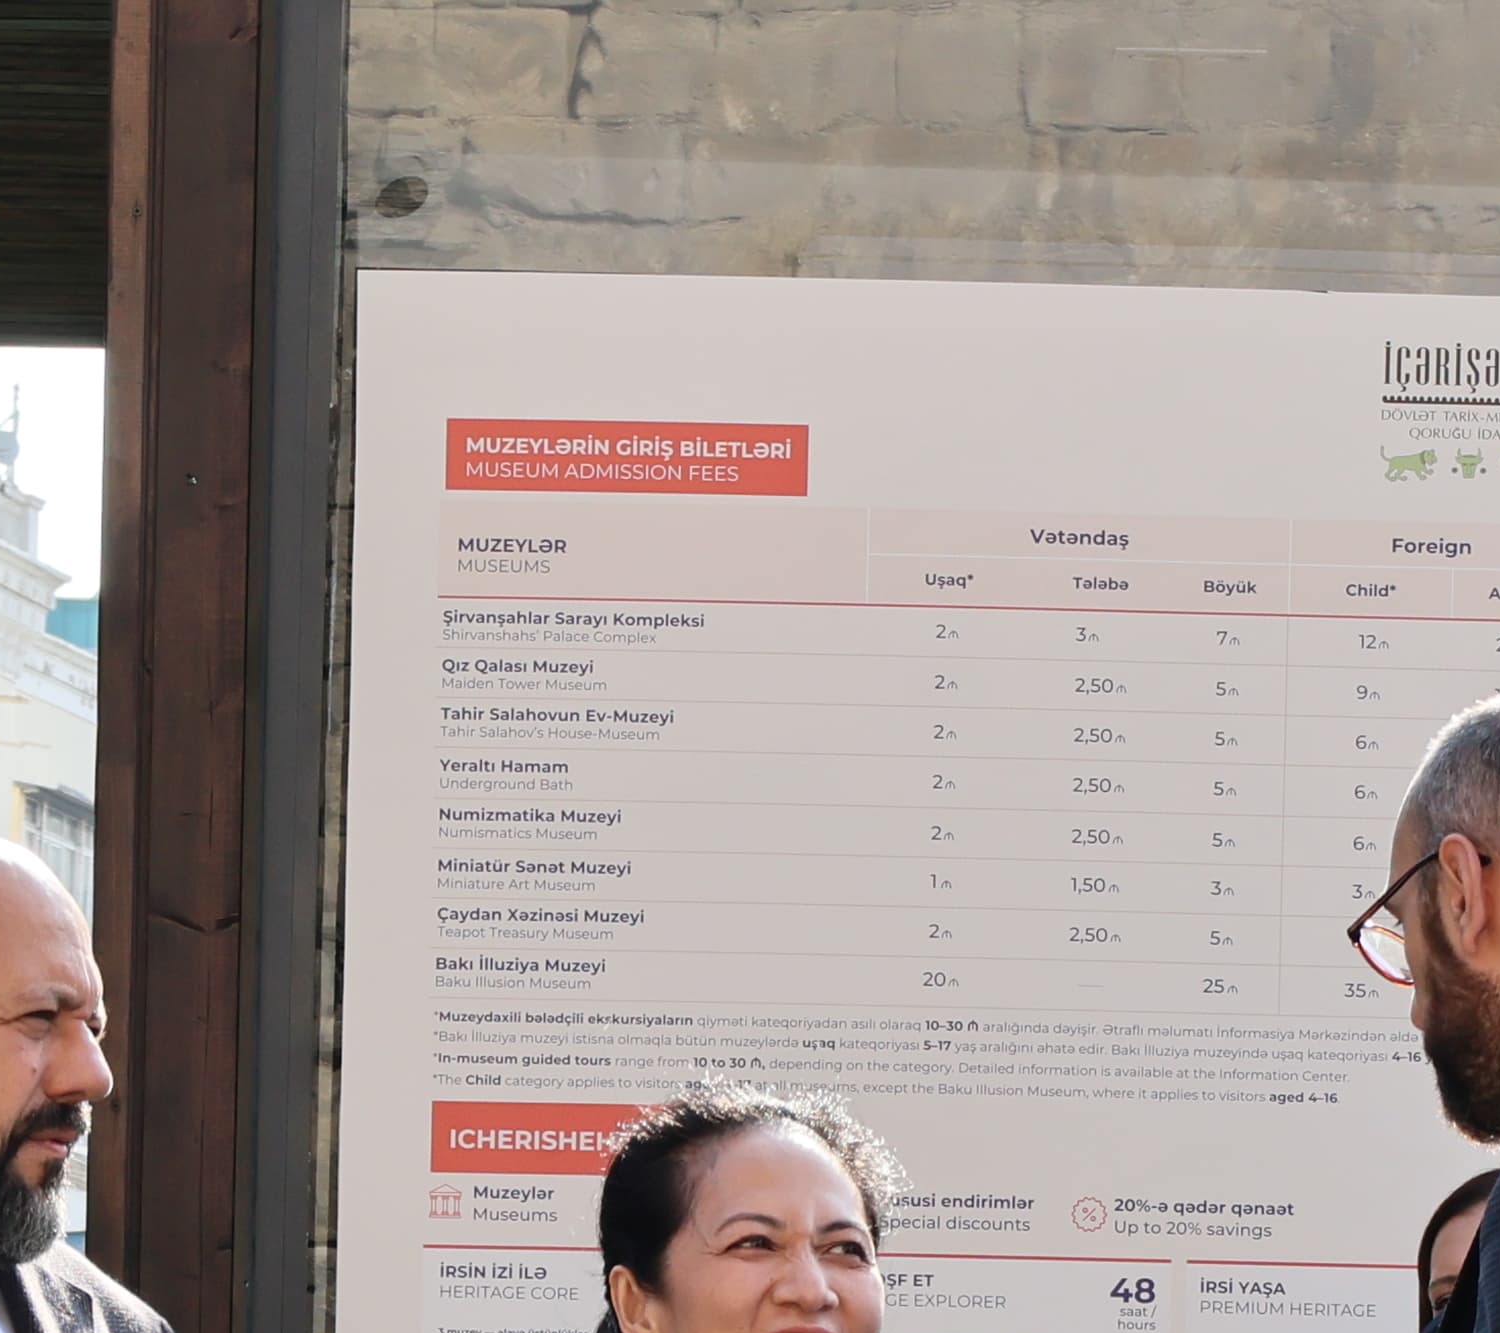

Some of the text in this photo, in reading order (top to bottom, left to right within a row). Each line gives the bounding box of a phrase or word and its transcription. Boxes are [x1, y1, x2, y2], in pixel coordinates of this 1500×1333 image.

[467, 435, 791, 461] MUZEYLƏRİN GİRİŞ BİLETLƏRİ
[467, 462, 738, 481] MUSEUM ADMISSION FEES
[459, 538, 566, 553] MUZEYLƏR
[1030, 529, 1129, 550] Vətəndaş
[1392, 538, 1471, 558] Foreign
[458, 559, 550, 573] MUSEUMS
[1073, 577, 1129, 590] Tələbə
[1204, 580, 1256, 596] Böyük
[443, 609, 705, 629] Şirvanşahlar Sarayı Kompleksi
[544, 630, 589, 642] Palace
[592, 631, 658, 646] Complex
[442, 659, 593, 676] Qız Qalası Muzeyi
[442, 677, 608, 691] Maiden Tower Museum
[441, 707, 674, 726] Tahir Salahovun Ev-Muzeyi
[440, 726, 475, 737] Tahir
[548, 728, 660, 740] House-Museum
[440, 759, 568, 773] Yeraltı Hamam
[440, 778, 573, 792] Underground Bath
[440, 808, 621, 826] Numizmatika Muzeyi
[439, 827, 597, 840] Numismatics Museum
[438, 858, 631, 877] Miniatür Sənət Muzeyi
[438, 877, 595, 891] Miniature Art Museum
[438, 907, 644, 926] Çaydan Xəzinəsi Muzeyi
[437, 926, 613, 941] Teapot Treasury Museum
[436, 954, 605, 975] Bakı İlluziya Muzeyi
[436, 975, 592, 989] Baku Illusion Museum
[522, 1053, 571, 1067] guided
[575, 1056, 611, 1066] tours
[615, 1058, 654, 1069] range
[658, 1056, 688, 1067] from
[693, 1057, 707, 1068] 10
[711, 1058, 726, 1068] to
[729, 1058, 746, 1068] 30
[769, 1059, 842, 1073] depending
[847, 1062, 863, 1070] on
[867, 1060, 889, 1071] the
[959, 1063, 1014, 1074] Detailed
[1019, 1064, 1096, 1076] information
[1101, 1068, 1111, 1076] is
[1114, 1067, 1172, 1078] available
[1176, 1069, 1189, 1078] at
[1193, 1068, 1215, 1079] the
[1220, 1069, 1298, 1080] Information
[474, 1186, 554, 1203] Muzeylər
[941, 1195, 1034, 1209] endirimlər
[473, 1208, 557, 1222] Museums
[1114, 1199, 1294, 1218] 20%-ə qədər qənaət
[946, 1216, 1030, 1231] discounts
[1115, 1220, 1272, 1240] Up to 20% savings
[440, 1262, 547, 1279] İRSİN İZİ İLƏ
[440, 1285, 579, 1300] HERITAGE CORE
[1110, 1278, 1155, 1303] 48
[1201, 1277, 1285, 1298] İRSİ YAŞA
[914, 1294, 1006, 1308] EXPLORER
[1200, 1300, 1376, 1317] PREMIUM HERITAGE
[1120, 1308, 1148, 1317] saat
[1118, 1319, 1156, 1330] hours
